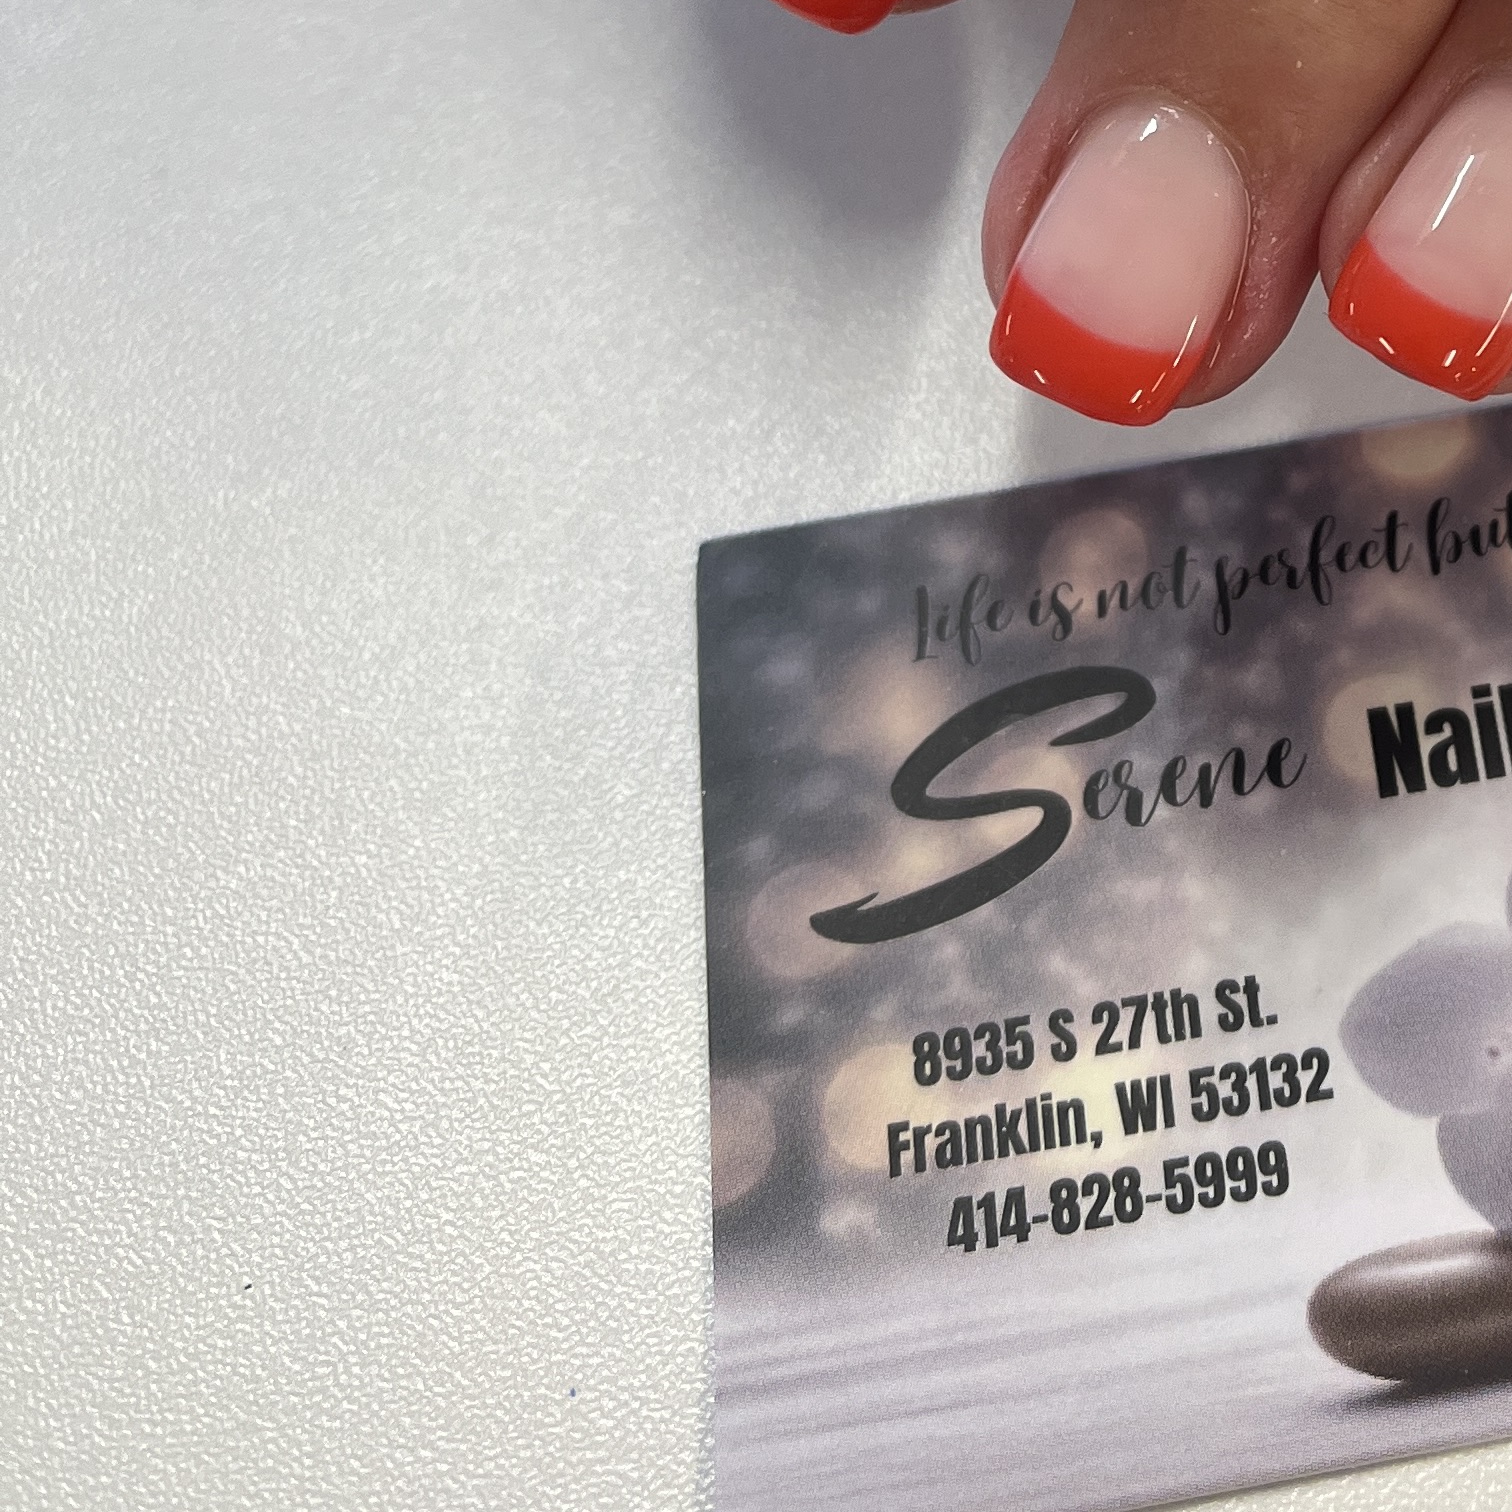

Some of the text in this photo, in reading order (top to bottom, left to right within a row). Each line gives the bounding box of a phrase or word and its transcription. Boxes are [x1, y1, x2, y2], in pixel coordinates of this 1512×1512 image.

[912, 573, 1013, 665] Life
[1028, 581, 1081, 642] is
[1096, 544, 1198, 619] not
[1213, 509, 1414, 636] perfect
[809, 665, 1307, 945] Serene
[912, 975, 1279, 1087] 8935 S 27th St.
[886, 1046, 1335, 1179] Franklin, WI 53132
[946, 1139, 1291, 1253] 414-828-5999
